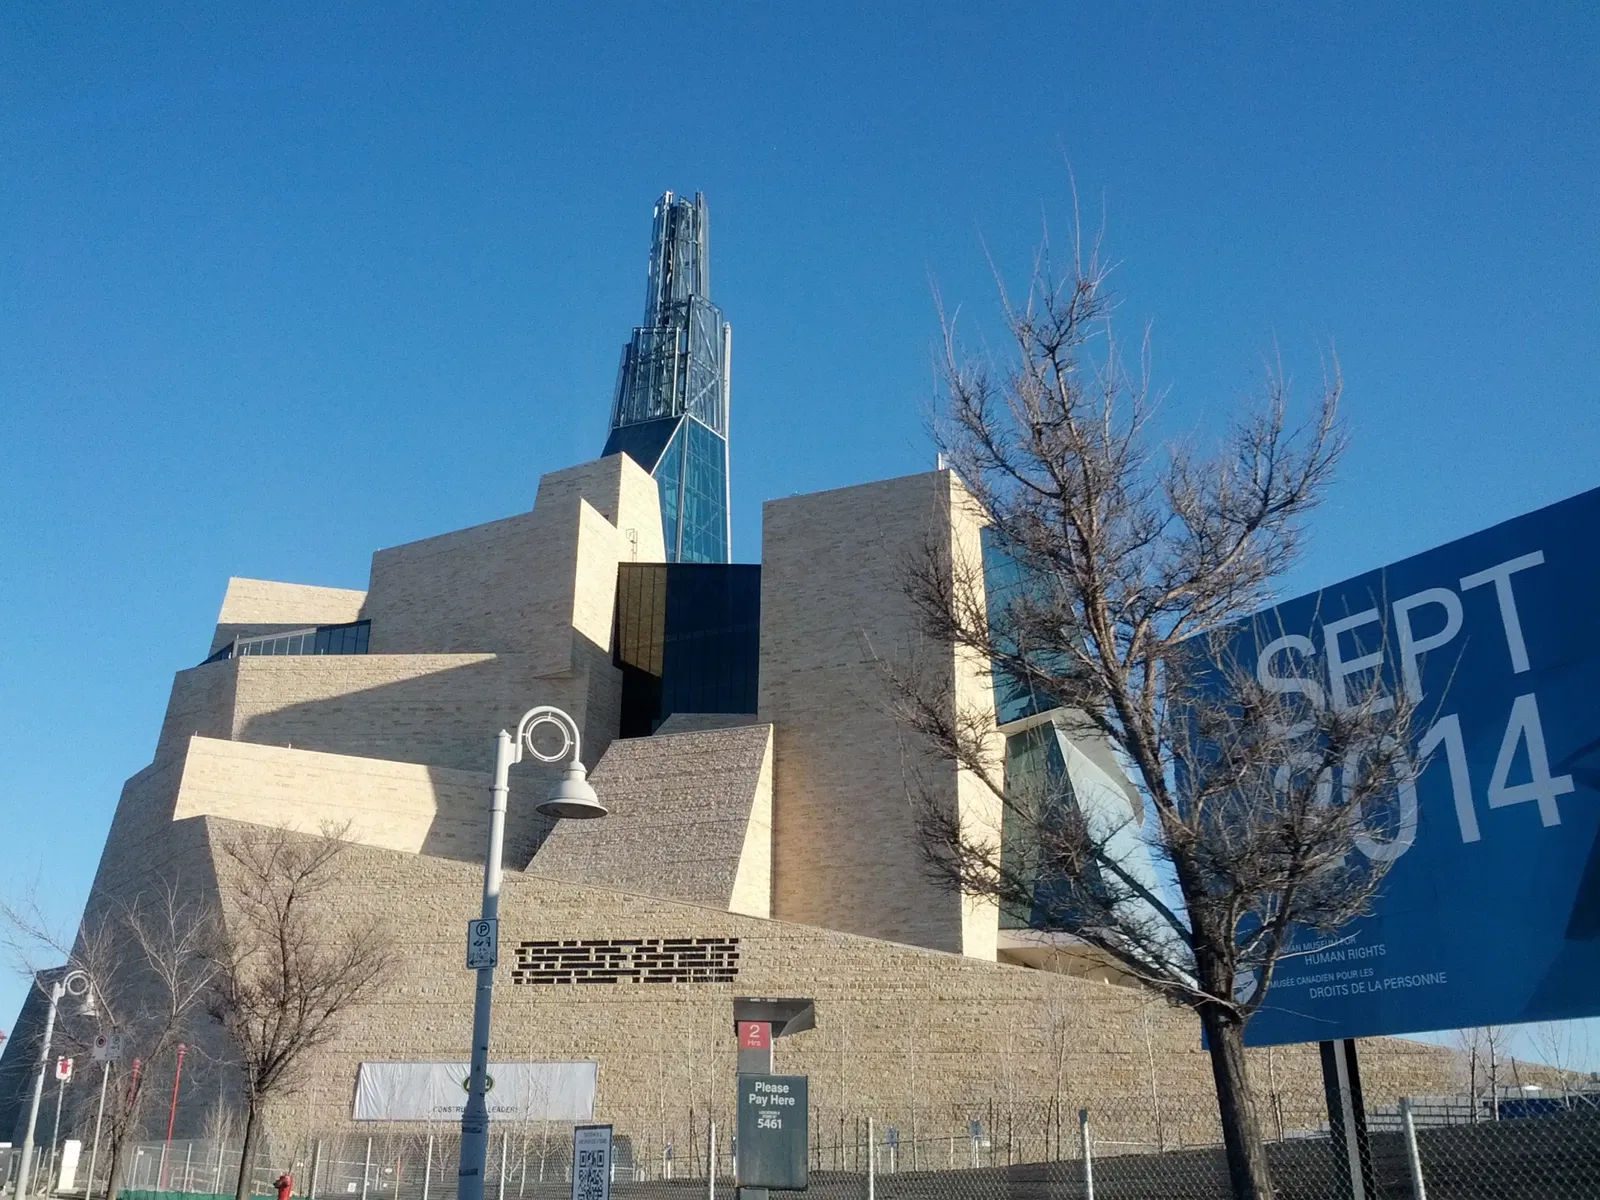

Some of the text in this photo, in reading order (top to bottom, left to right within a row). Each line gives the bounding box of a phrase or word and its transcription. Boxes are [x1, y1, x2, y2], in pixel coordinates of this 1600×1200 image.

[1256, 550, 1546, 740] SEPT
[1304, 949, 1346, 966] HUMAN
[1348, 944, 1387, 960] RIGHTS
[1269, 967, 1374, 989] MUSÉE CANADIEN POUR LES
[1309, 971, 1448, 999] DROITS DE LA PERSONNE
[749, 1024, 760, 1038] 2
[747, 1039, 761, 1047] Hrs
[755, 1081, 790, 1094] Please
[748, 1093, 796, 1107] Pay Here
[757, 1118, 782, 1130] 5461
